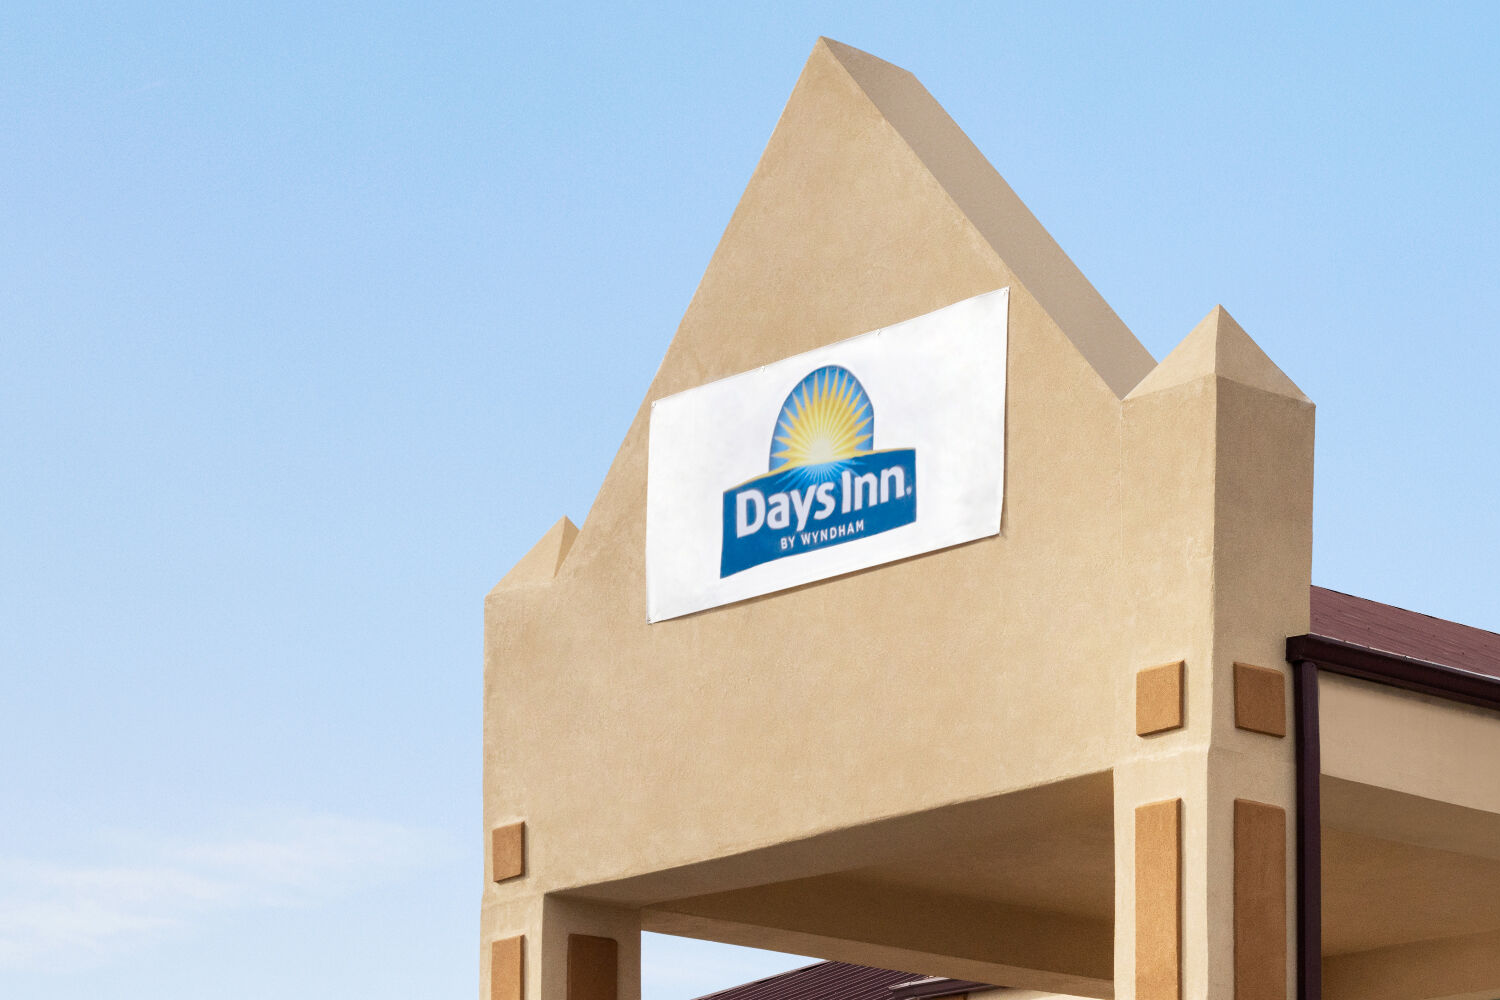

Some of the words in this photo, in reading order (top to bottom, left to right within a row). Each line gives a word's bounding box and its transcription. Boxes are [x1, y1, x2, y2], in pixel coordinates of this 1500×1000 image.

[736, 482, 836, 539] Days
[780, 535, 796, 550] BY
[801, 519, 865, 546] WYNDHAM
